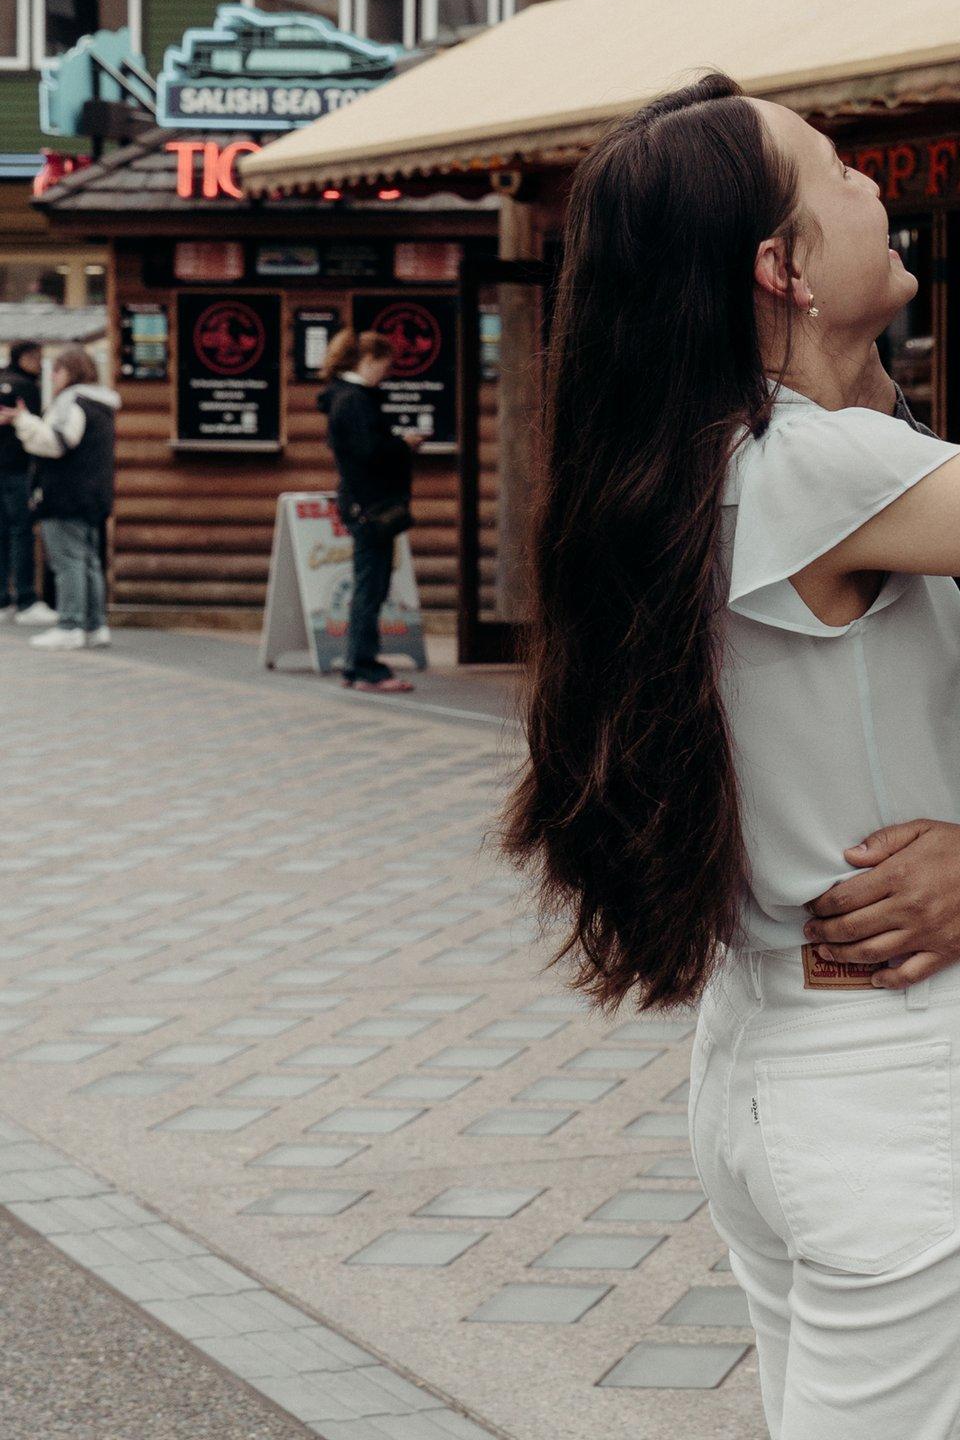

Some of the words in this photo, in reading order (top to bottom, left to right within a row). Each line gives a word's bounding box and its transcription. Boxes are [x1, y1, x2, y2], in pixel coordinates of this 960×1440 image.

[179, 88, 269, 114] SALISH
[271, 88, 323, 114] SEA
[323, 89, 367, 111] TO
